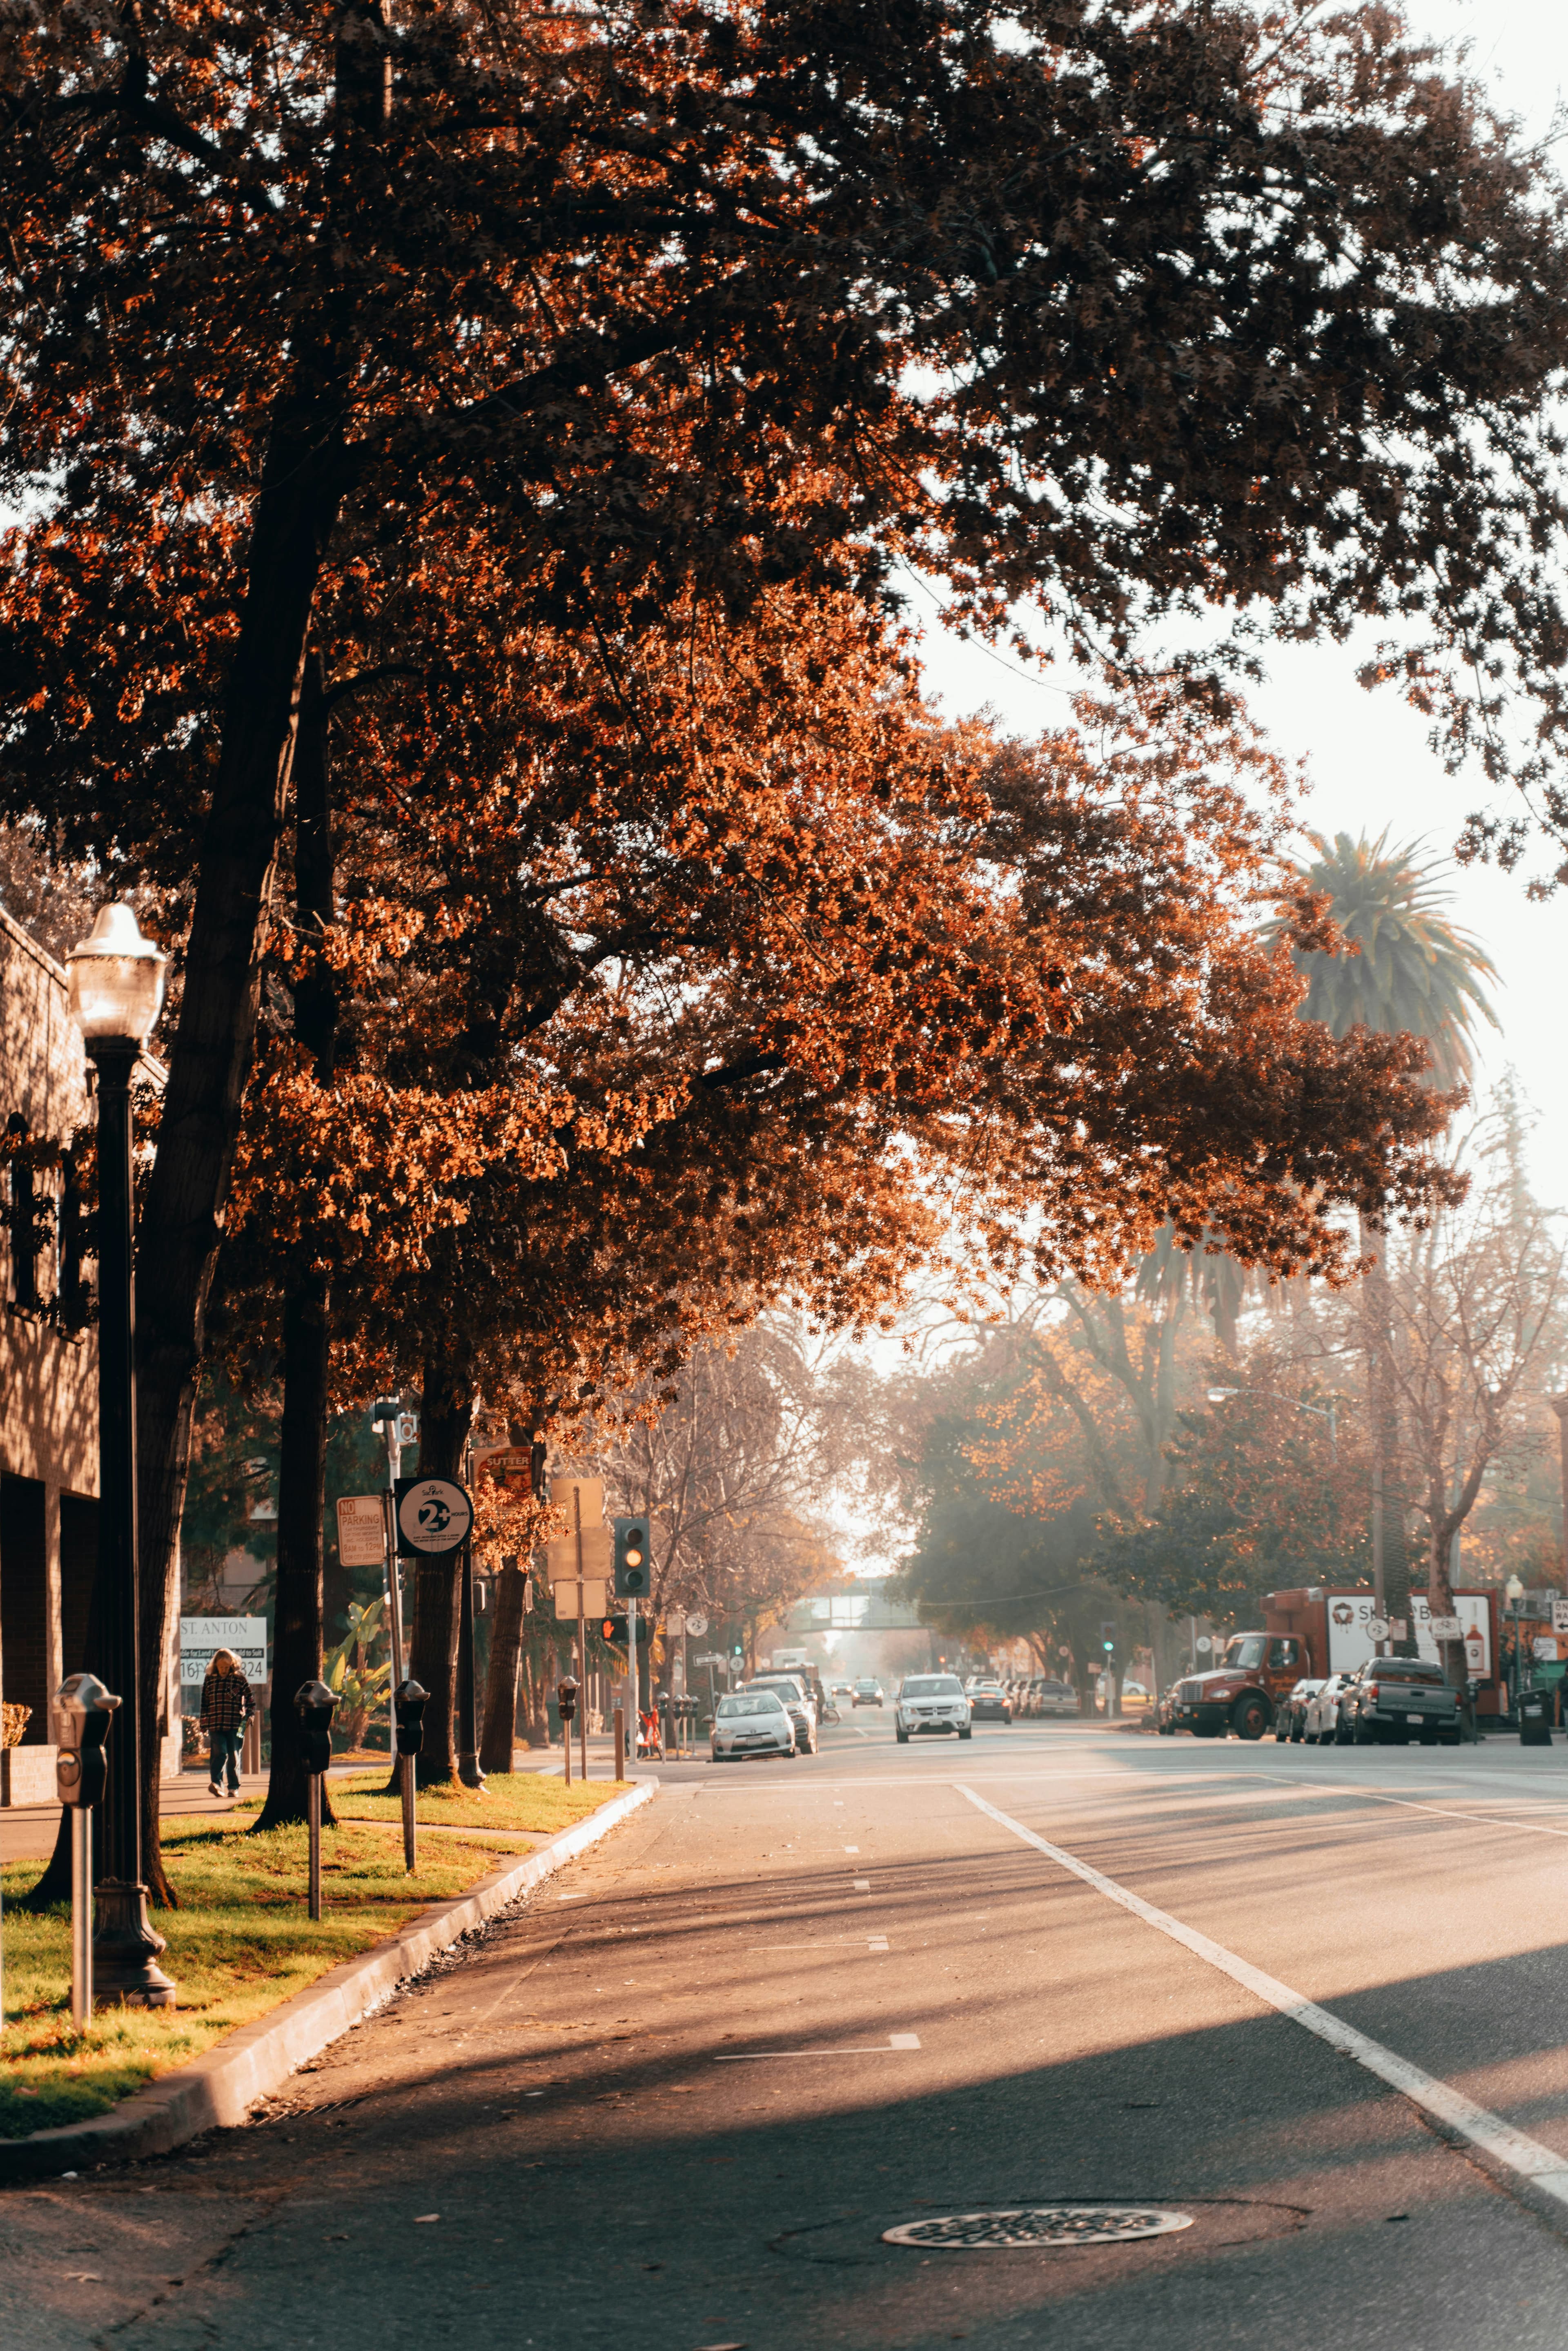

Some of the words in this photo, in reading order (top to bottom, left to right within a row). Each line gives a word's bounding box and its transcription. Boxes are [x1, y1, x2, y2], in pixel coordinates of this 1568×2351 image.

[487, 1457, 530, 1466] SUTTER
[341, 1501, 354, 1514] NO
[342, 1514, 379, 1526] PARKING
[181, 1622, 198, 1634] ST.
[202, 1622, 247, 1634] ANTON
